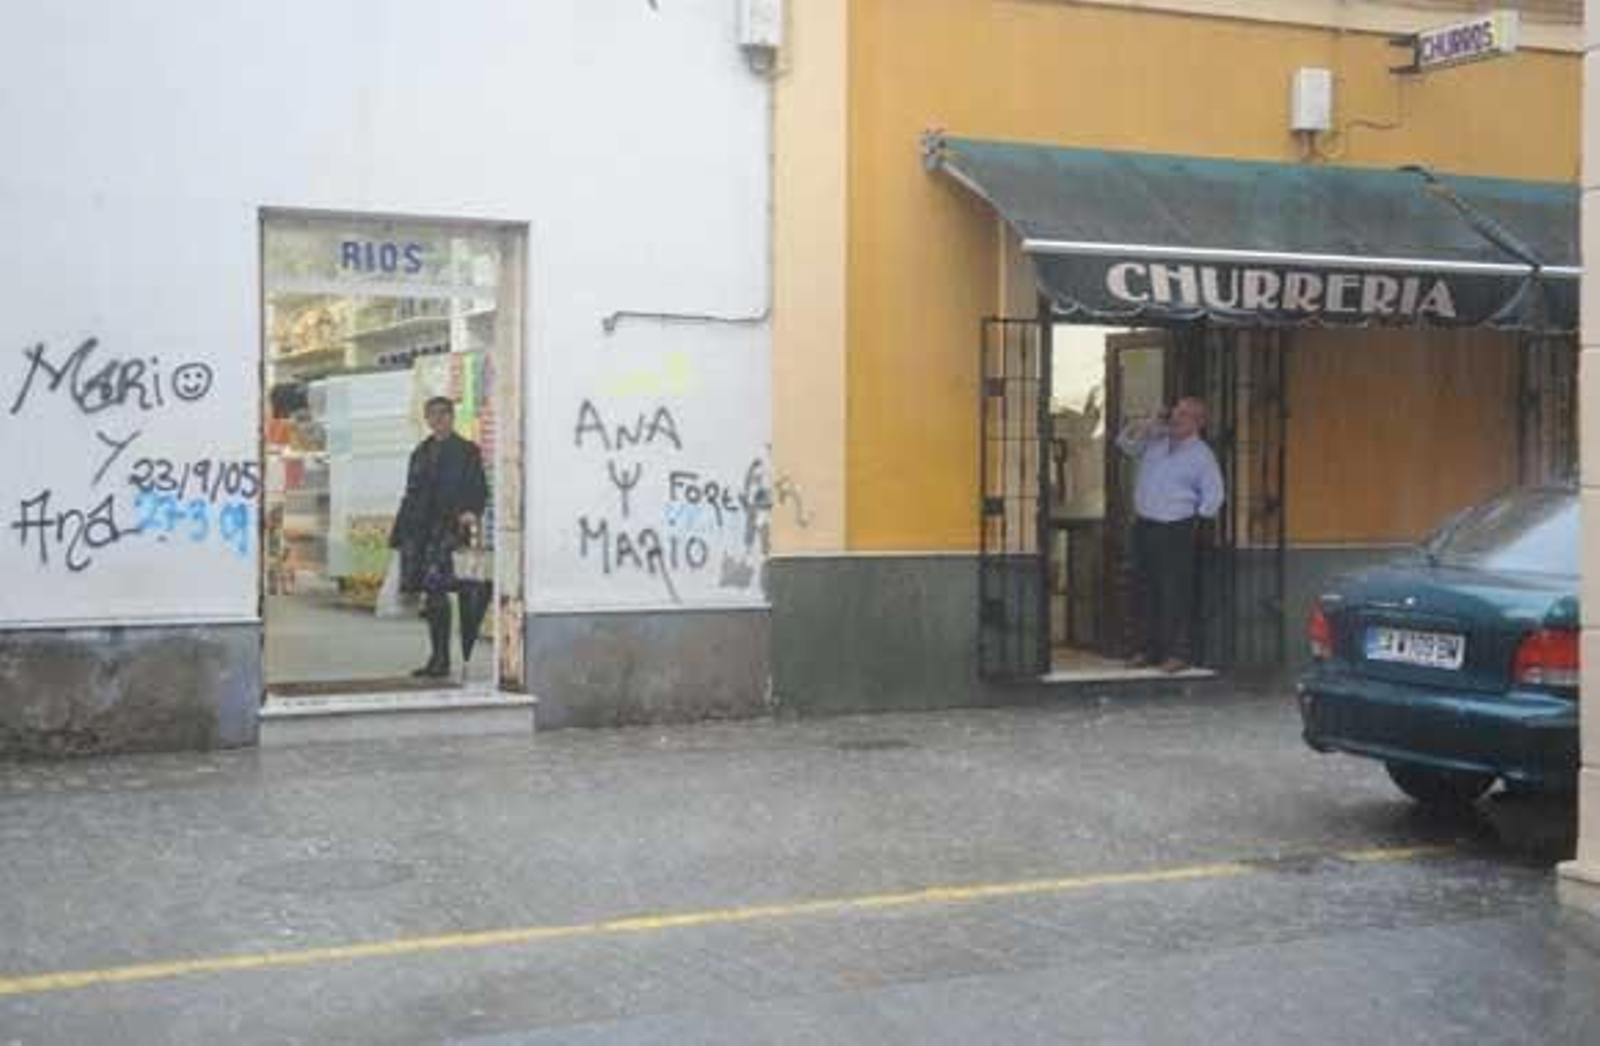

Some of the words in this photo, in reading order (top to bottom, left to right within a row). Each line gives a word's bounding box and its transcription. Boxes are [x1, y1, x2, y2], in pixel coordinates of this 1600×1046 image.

[341, 241, 423, 274] RIOS
[1106, 262, 1456, 318] CHURRERIA
[95, 429, 141, 486] Y
